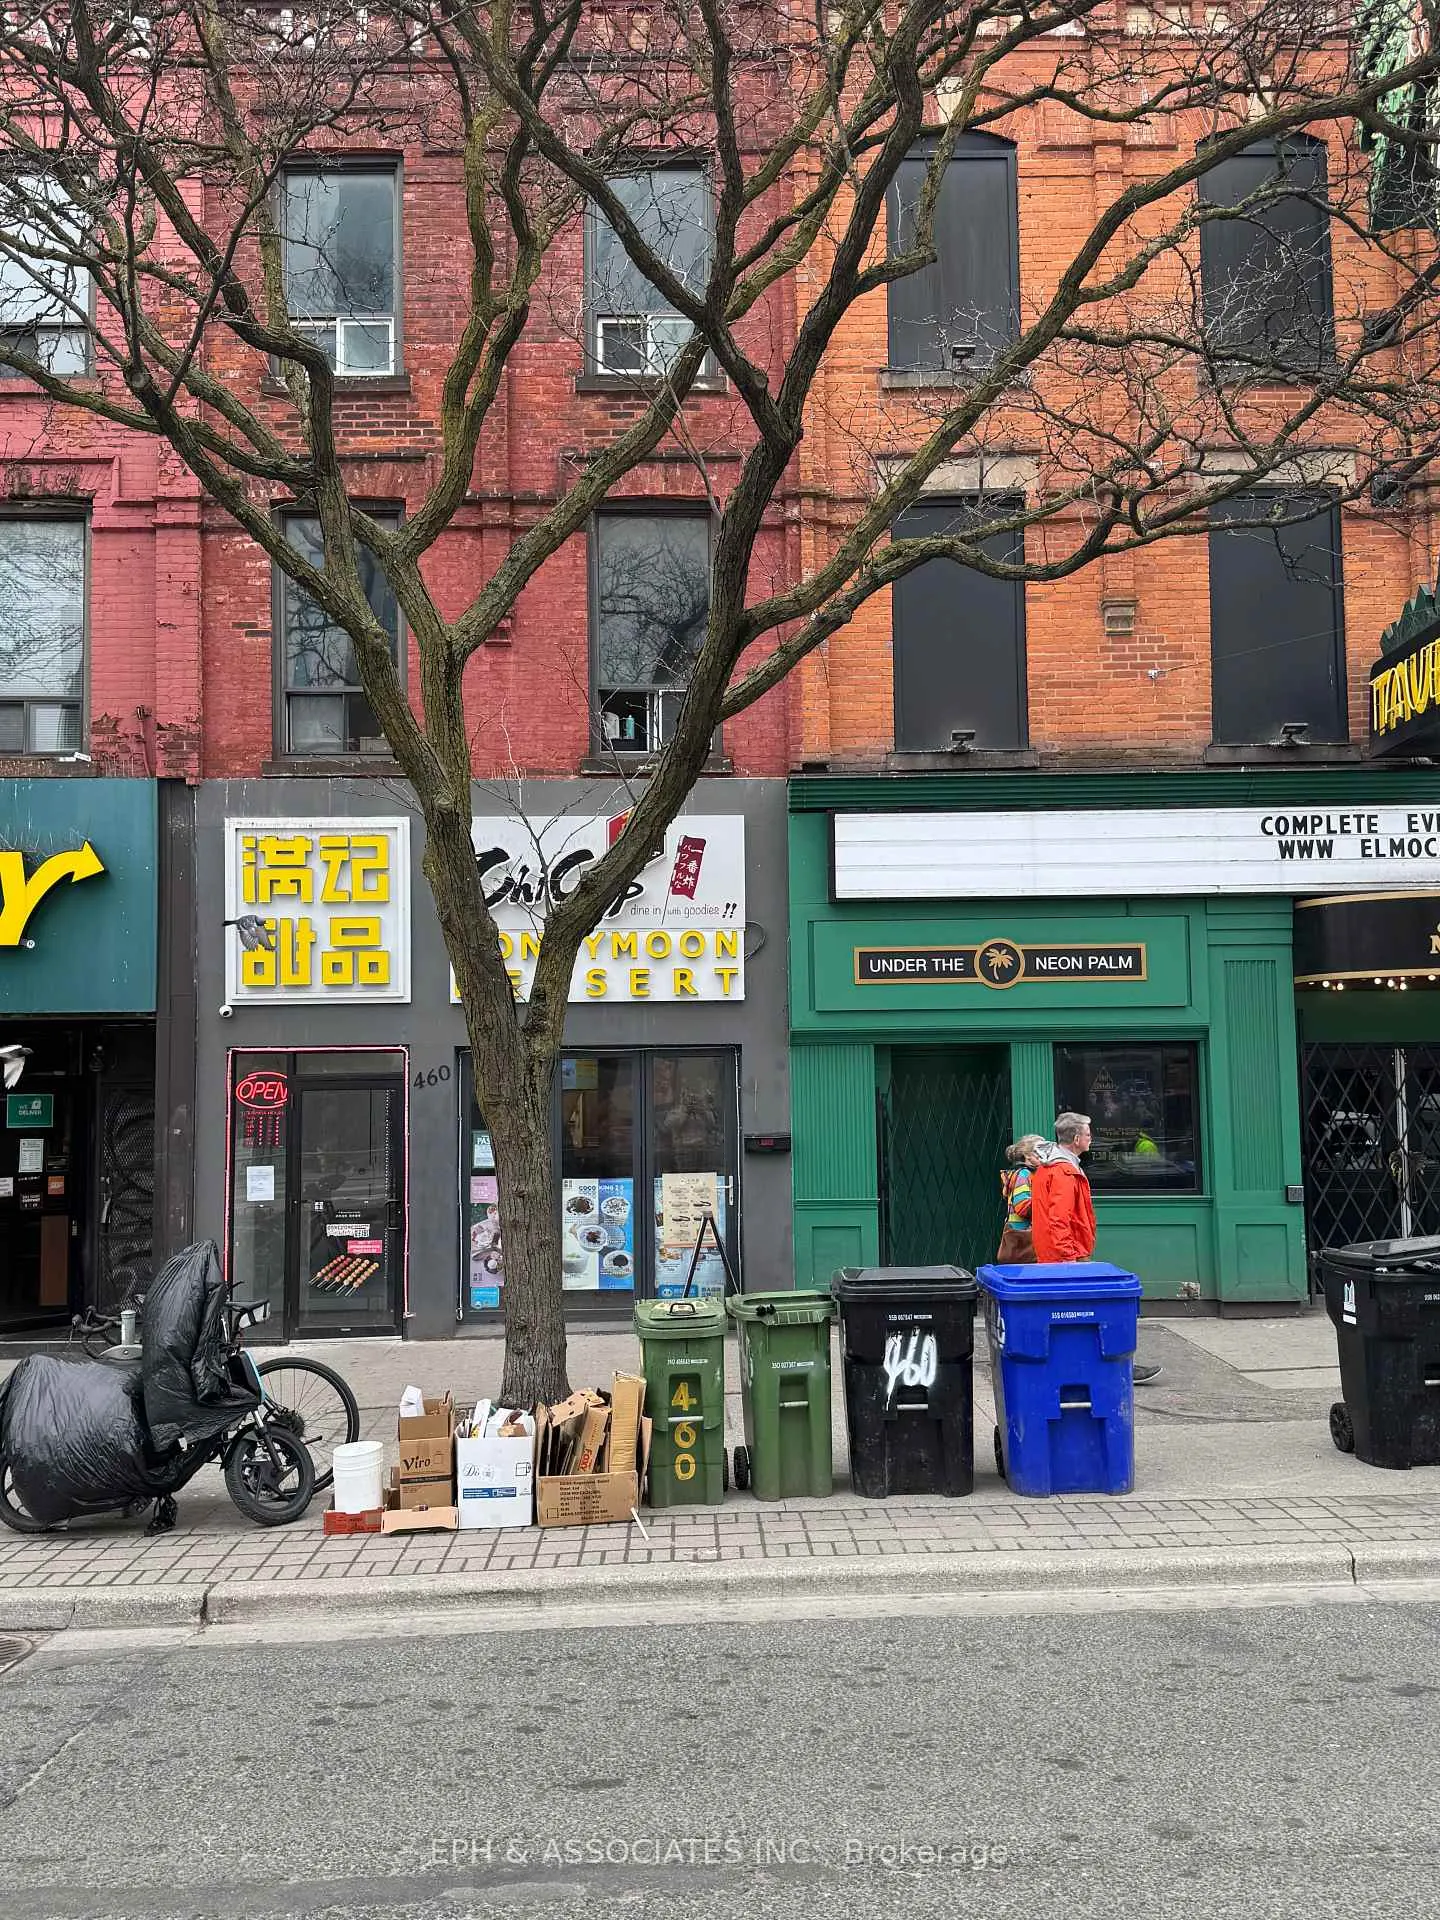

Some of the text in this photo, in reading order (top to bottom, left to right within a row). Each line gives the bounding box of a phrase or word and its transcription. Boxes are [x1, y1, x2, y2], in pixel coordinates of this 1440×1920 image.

[1260, 813, 1440, 836] COMPLETE EV
[1278, 837, 1440, 860] WWW ELMOC
[630, 903, 650, 916] dine
[652, 904, 662, 916] in
[869, 955, 1133, 973] UNDER THE NEON PALM
[413, 1064, 451, 1089] 460
[239, 1081, 288, 1100] OPEN
[883, 1326, 937, 1396] 460
